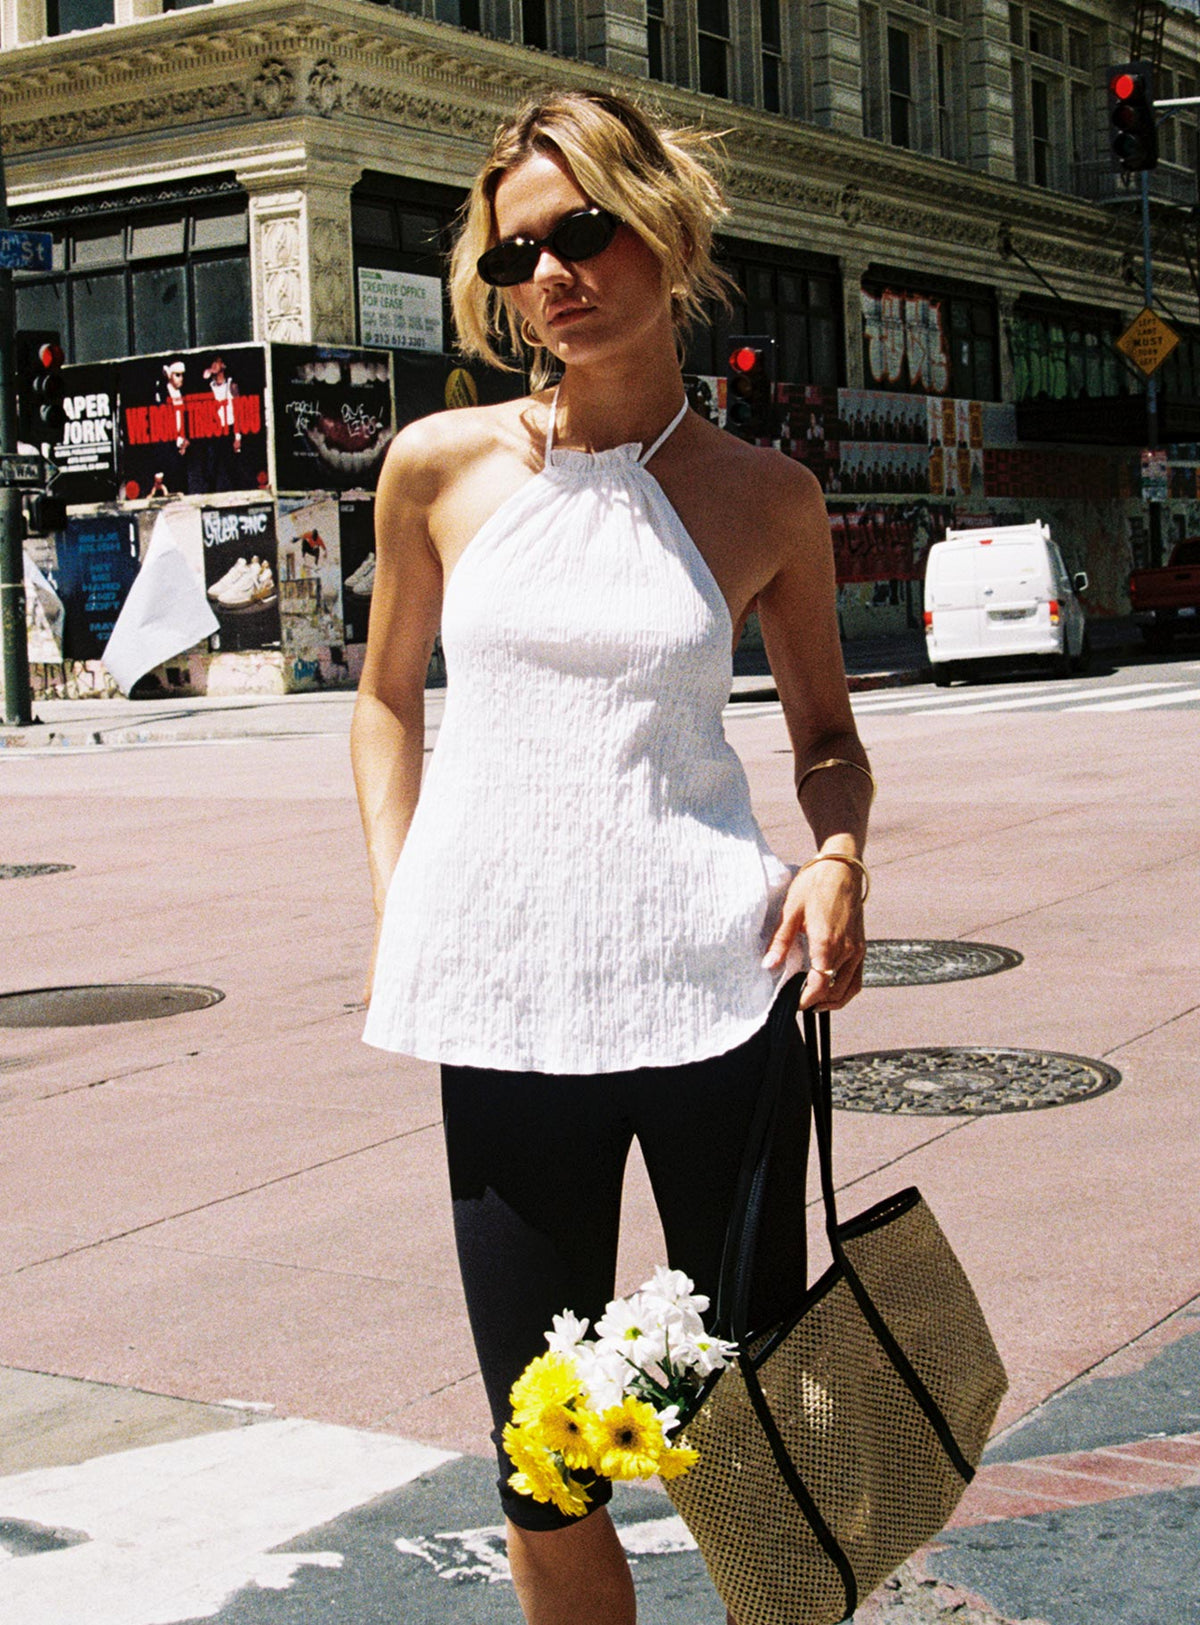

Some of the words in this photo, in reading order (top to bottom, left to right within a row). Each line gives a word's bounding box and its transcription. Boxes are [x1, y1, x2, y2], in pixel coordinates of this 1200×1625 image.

[21, 241, 44, 262] St
[1133, 336, 1163, 347] MUST
[125, 405, 150, 445] WE
